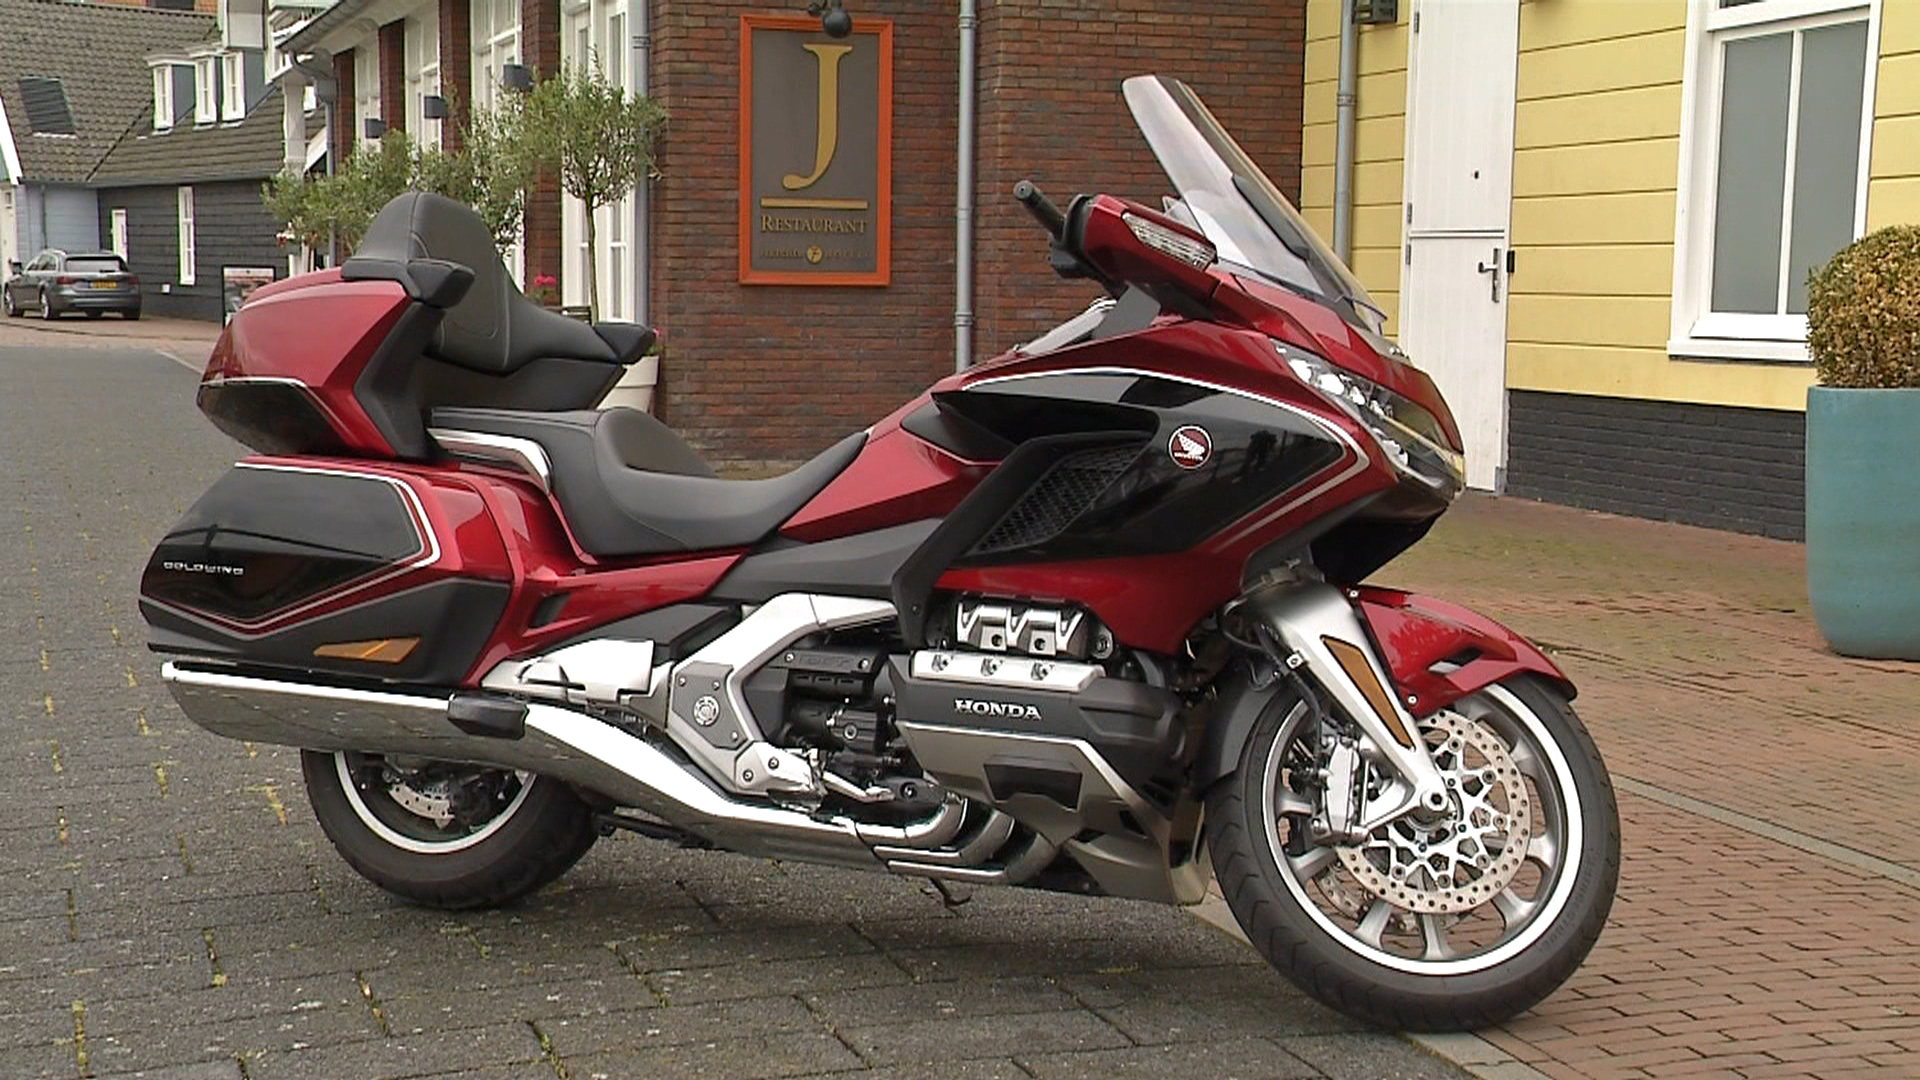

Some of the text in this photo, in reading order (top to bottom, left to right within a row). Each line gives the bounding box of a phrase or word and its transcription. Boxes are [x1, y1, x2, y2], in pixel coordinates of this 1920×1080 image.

[783, 43, 853, 190] J
[761, 214, 867, 234] RESTAURANT
[954, 699, 1042, 720] HONDA
